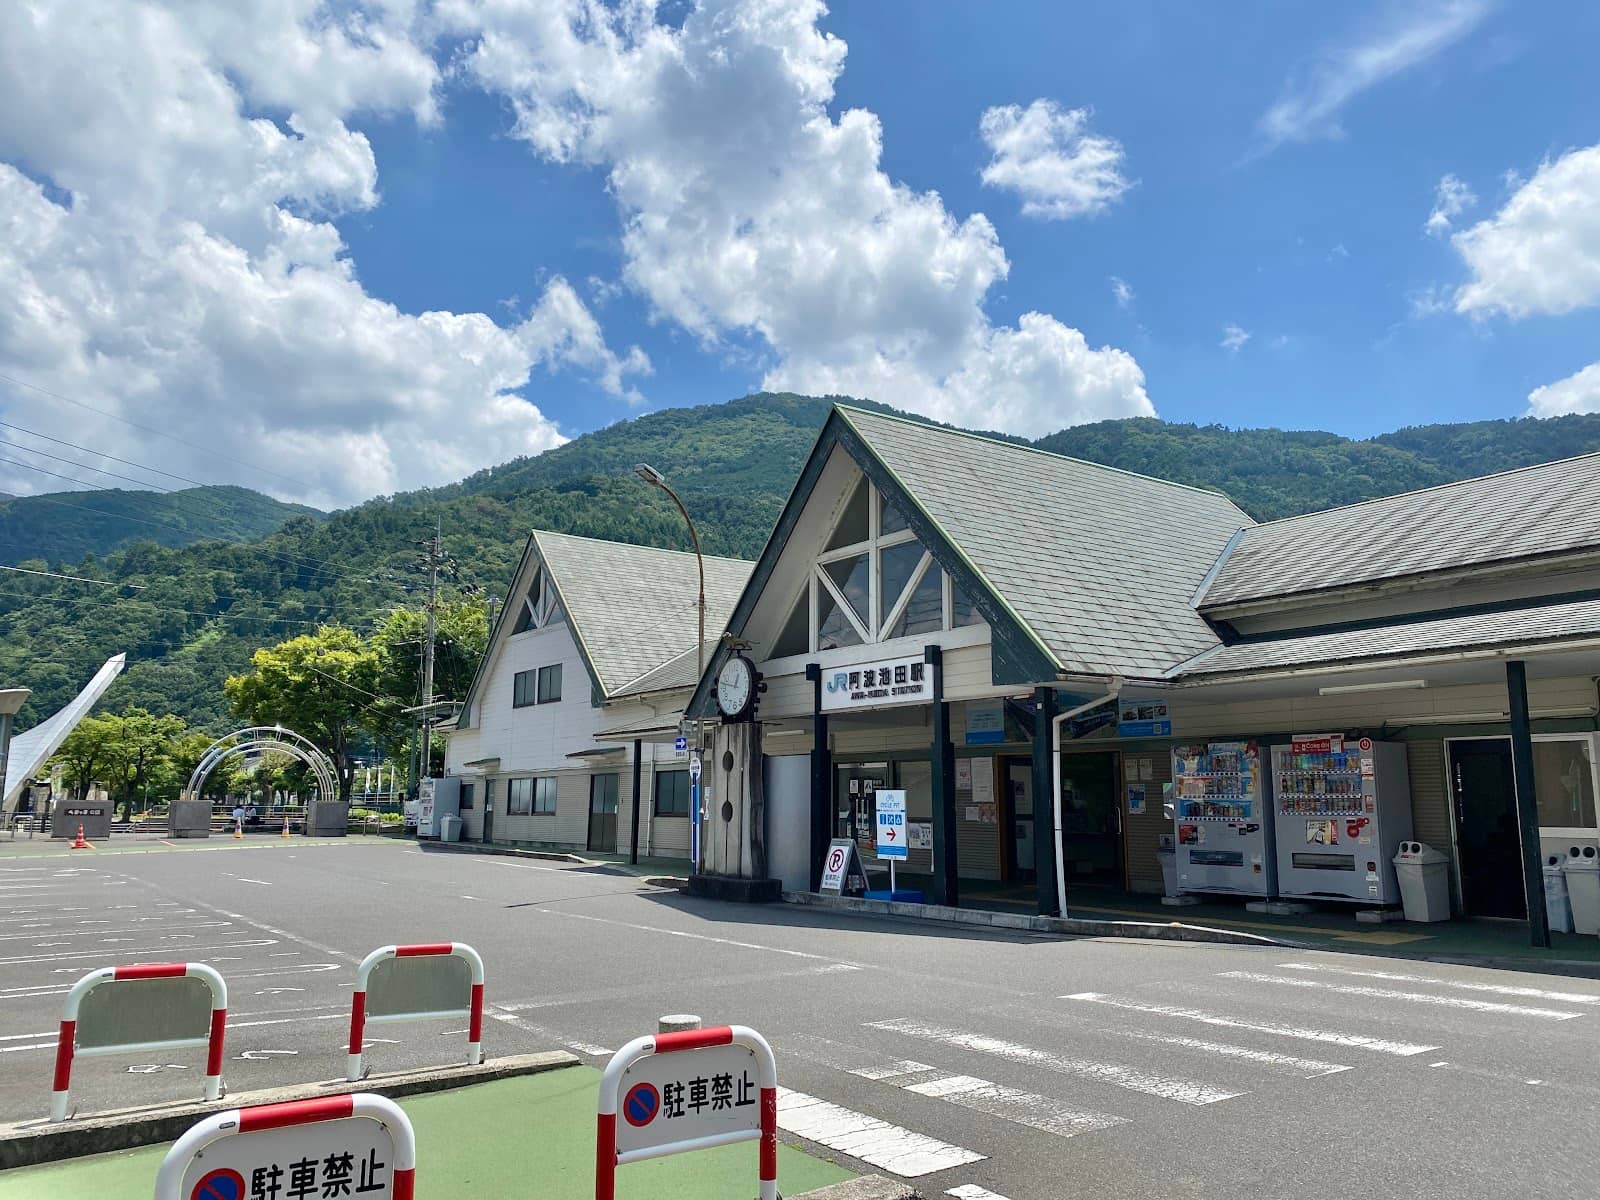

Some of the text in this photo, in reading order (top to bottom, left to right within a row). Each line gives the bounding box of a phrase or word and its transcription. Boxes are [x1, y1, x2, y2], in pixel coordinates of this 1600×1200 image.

[826, 662, 925, 694] JR 阿波池田駅
[891, 684, 924, 696] STATION
[663, 1069, 756, 1120] 駐車禁止
[250, 1147, 386, 1200] 駐車禁止
